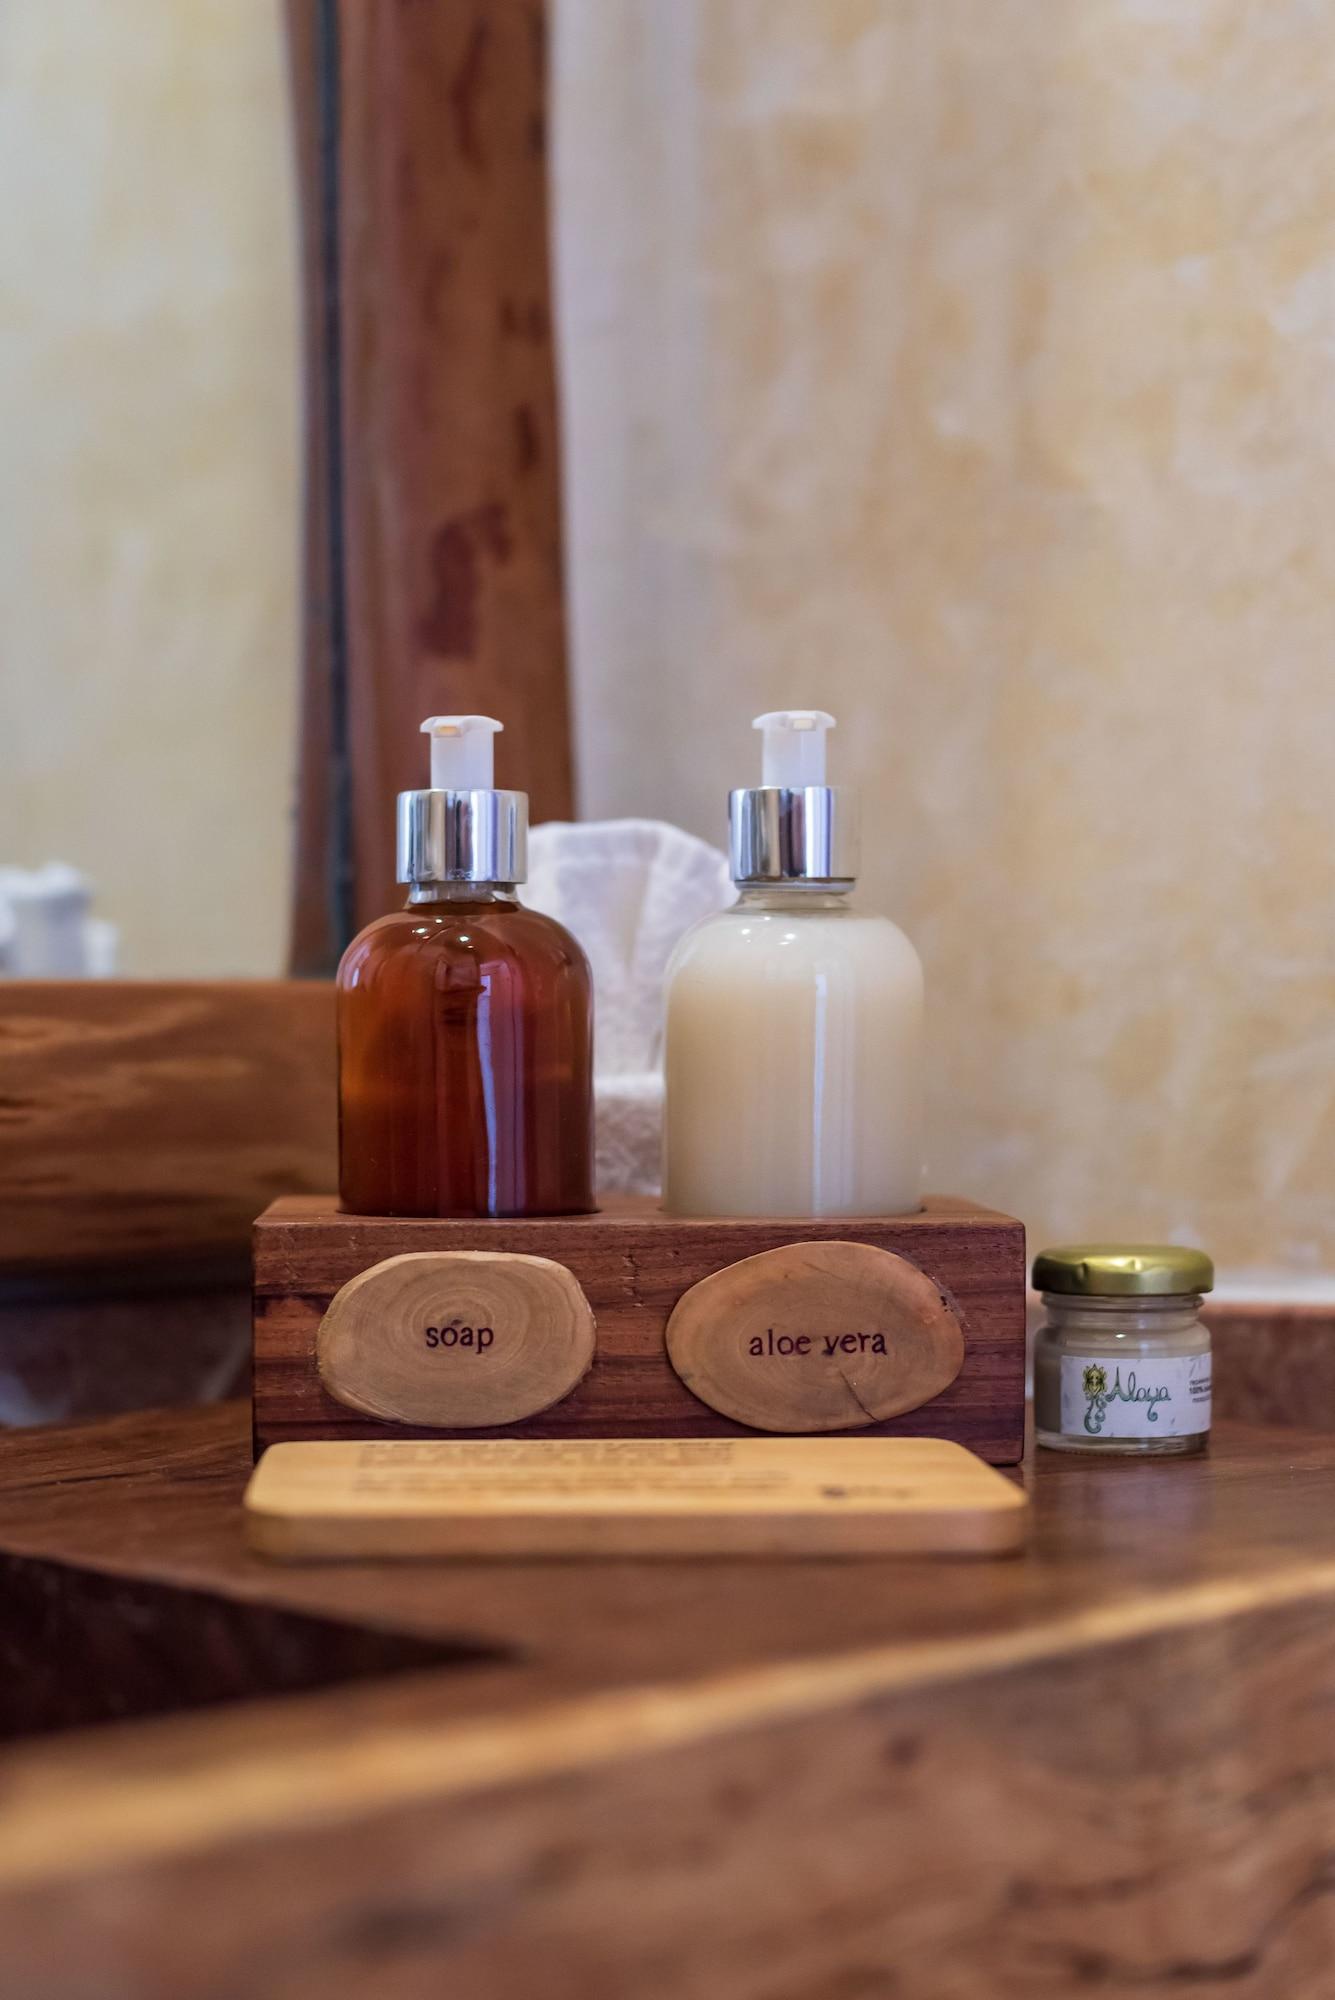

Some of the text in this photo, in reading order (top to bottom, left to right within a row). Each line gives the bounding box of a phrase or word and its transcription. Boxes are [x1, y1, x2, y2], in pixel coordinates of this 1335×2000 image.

[426, 1327, 494, 1355] soap
[749, 1328, 888, 1356] aloe vera
[1105, 1366, 1172, 1422] Alaya
